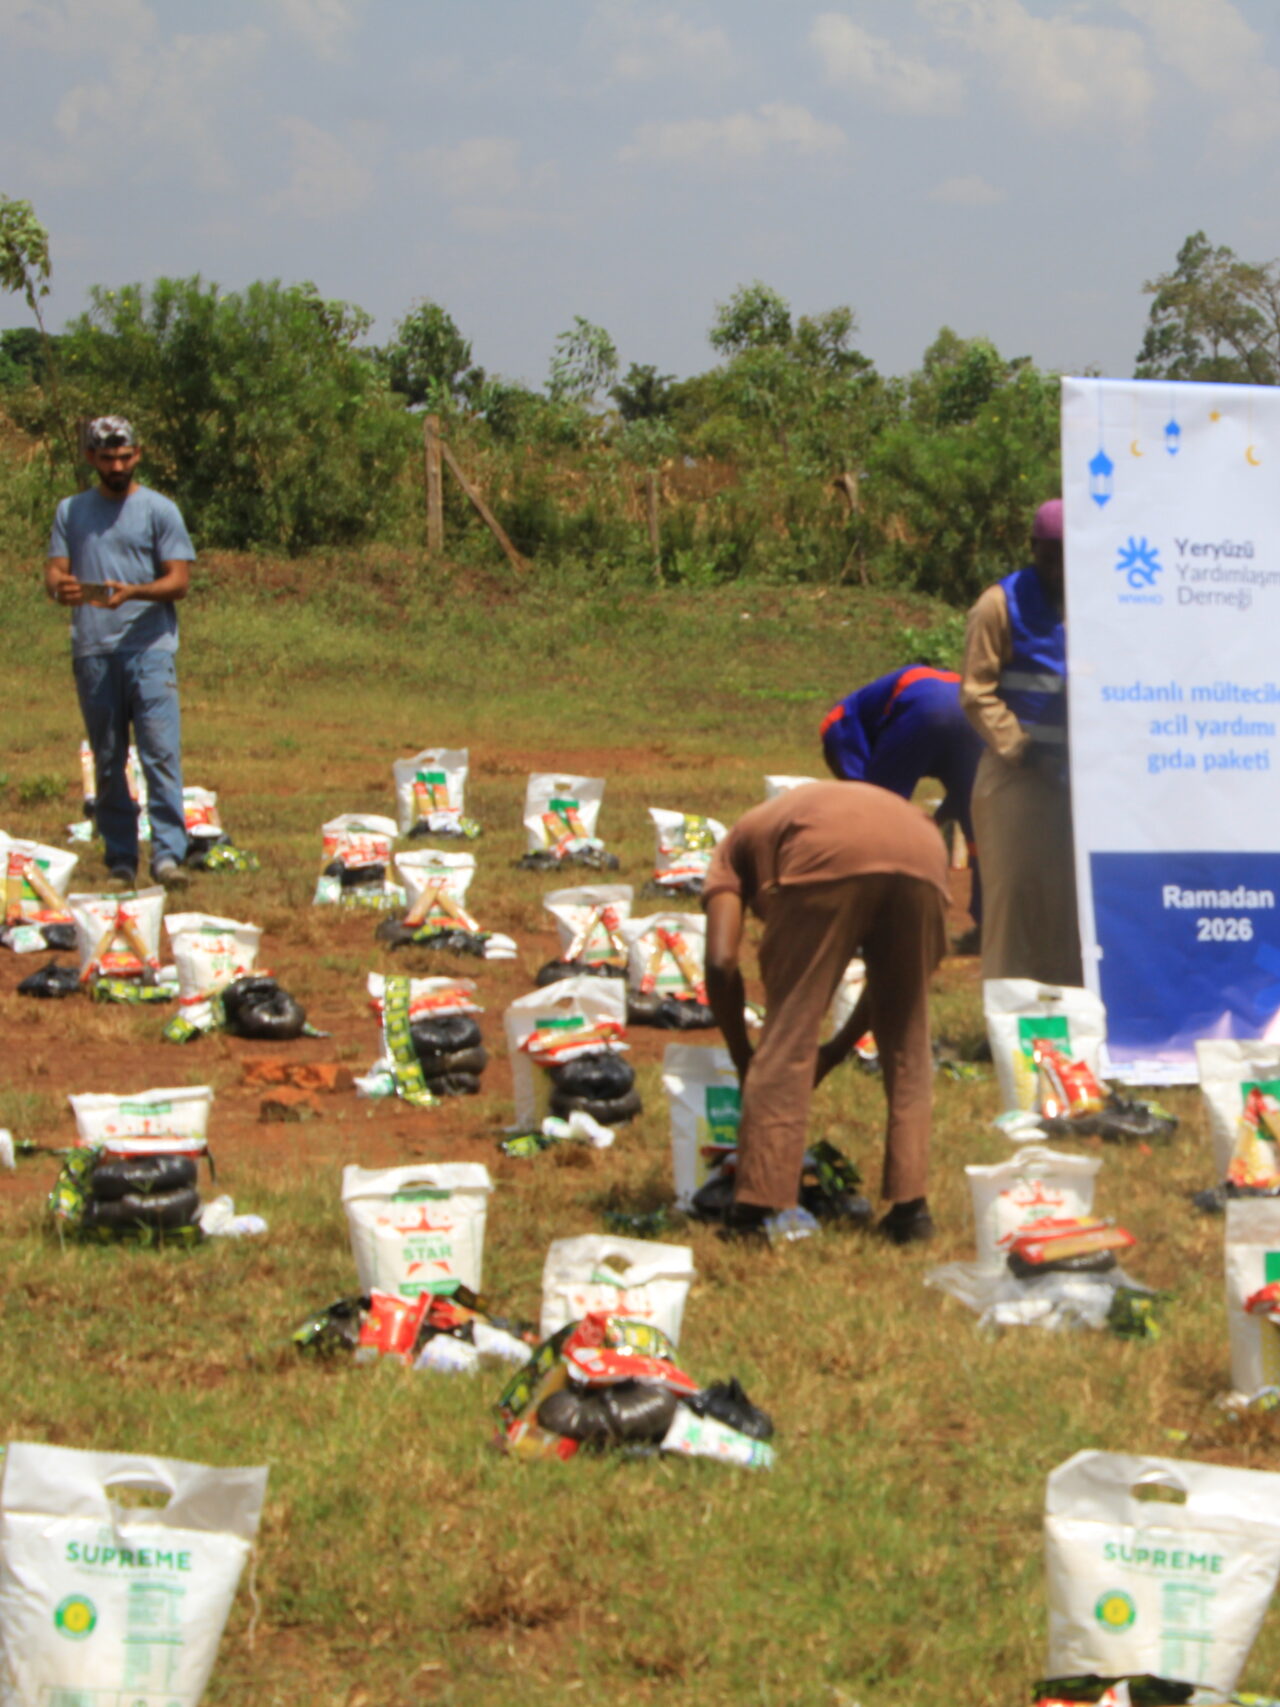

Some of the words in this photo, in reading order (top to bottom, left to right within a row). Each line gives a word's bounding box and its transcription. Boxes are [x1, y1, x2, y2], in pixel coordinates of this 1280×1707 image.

[1174, 538, 1255, 560] Yeryüzü
[1177, 586, 1252, 610] Derneği
[1101, 681, 1183, 702] sudanlı
[1150, 714, 1188, 736] acil
[1195, 715, 1276, 740] yardımı
[1147, 748, 1196, 774] gıda
[1203, 748, 1270, 773] paketi
[1162, 884, 1275, 909] Ramadan
[1196, 917, 1254, 942] 2026
[66, 1541, 192, 1572] SUPREME
[1104, 1542, 1225, 1575] SUPREME
